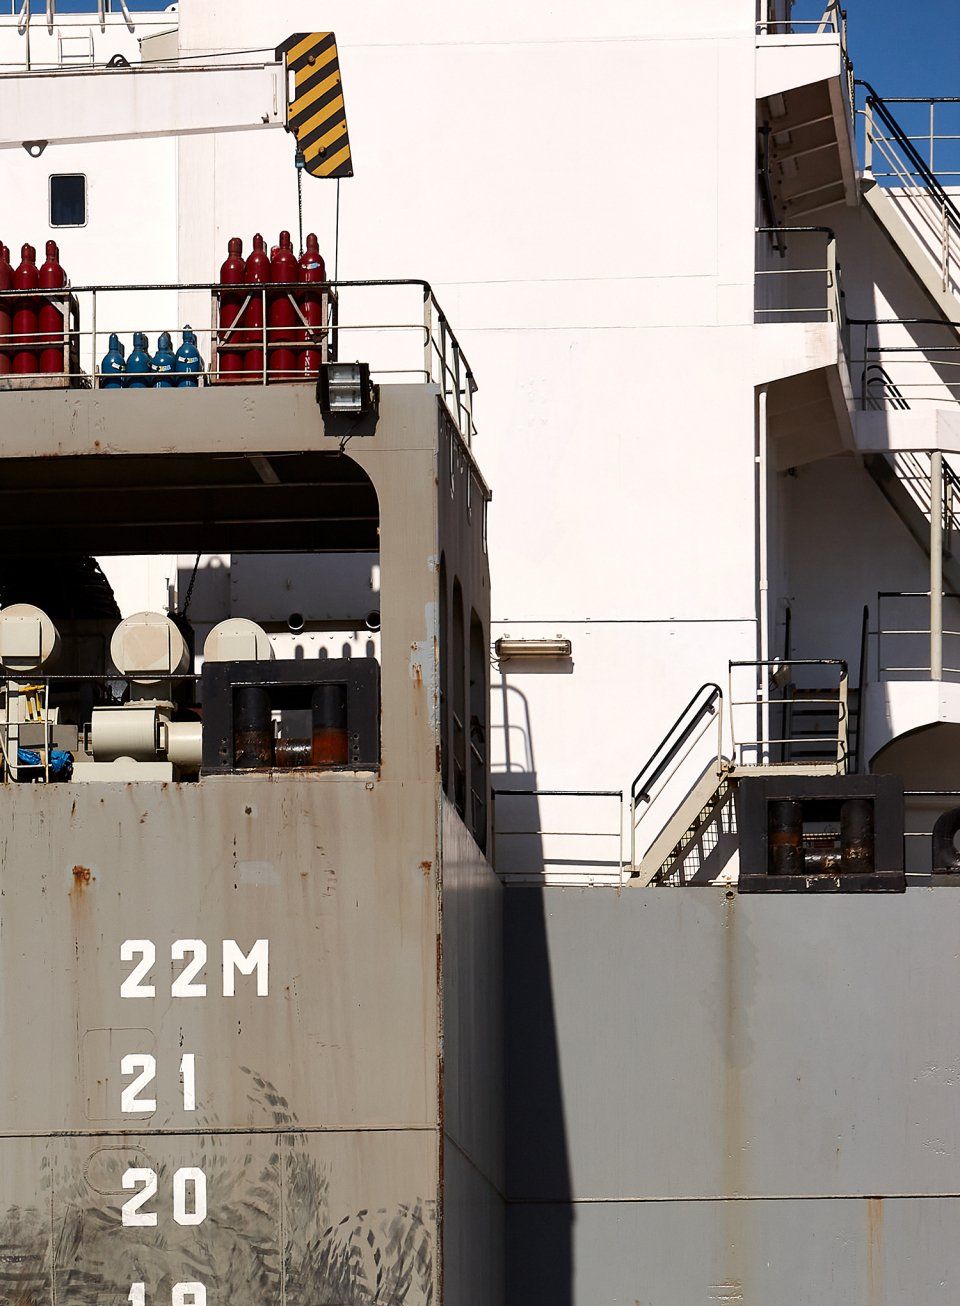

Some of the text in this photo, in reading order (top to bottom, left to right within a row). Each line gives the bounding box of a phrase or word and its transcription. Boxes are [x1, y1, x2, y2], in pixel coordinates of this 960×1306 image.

[121, 938, 269, 998] 22M
[121, 1054, 196, 1112] 21
[121, 1167, 207, 1226] 20
